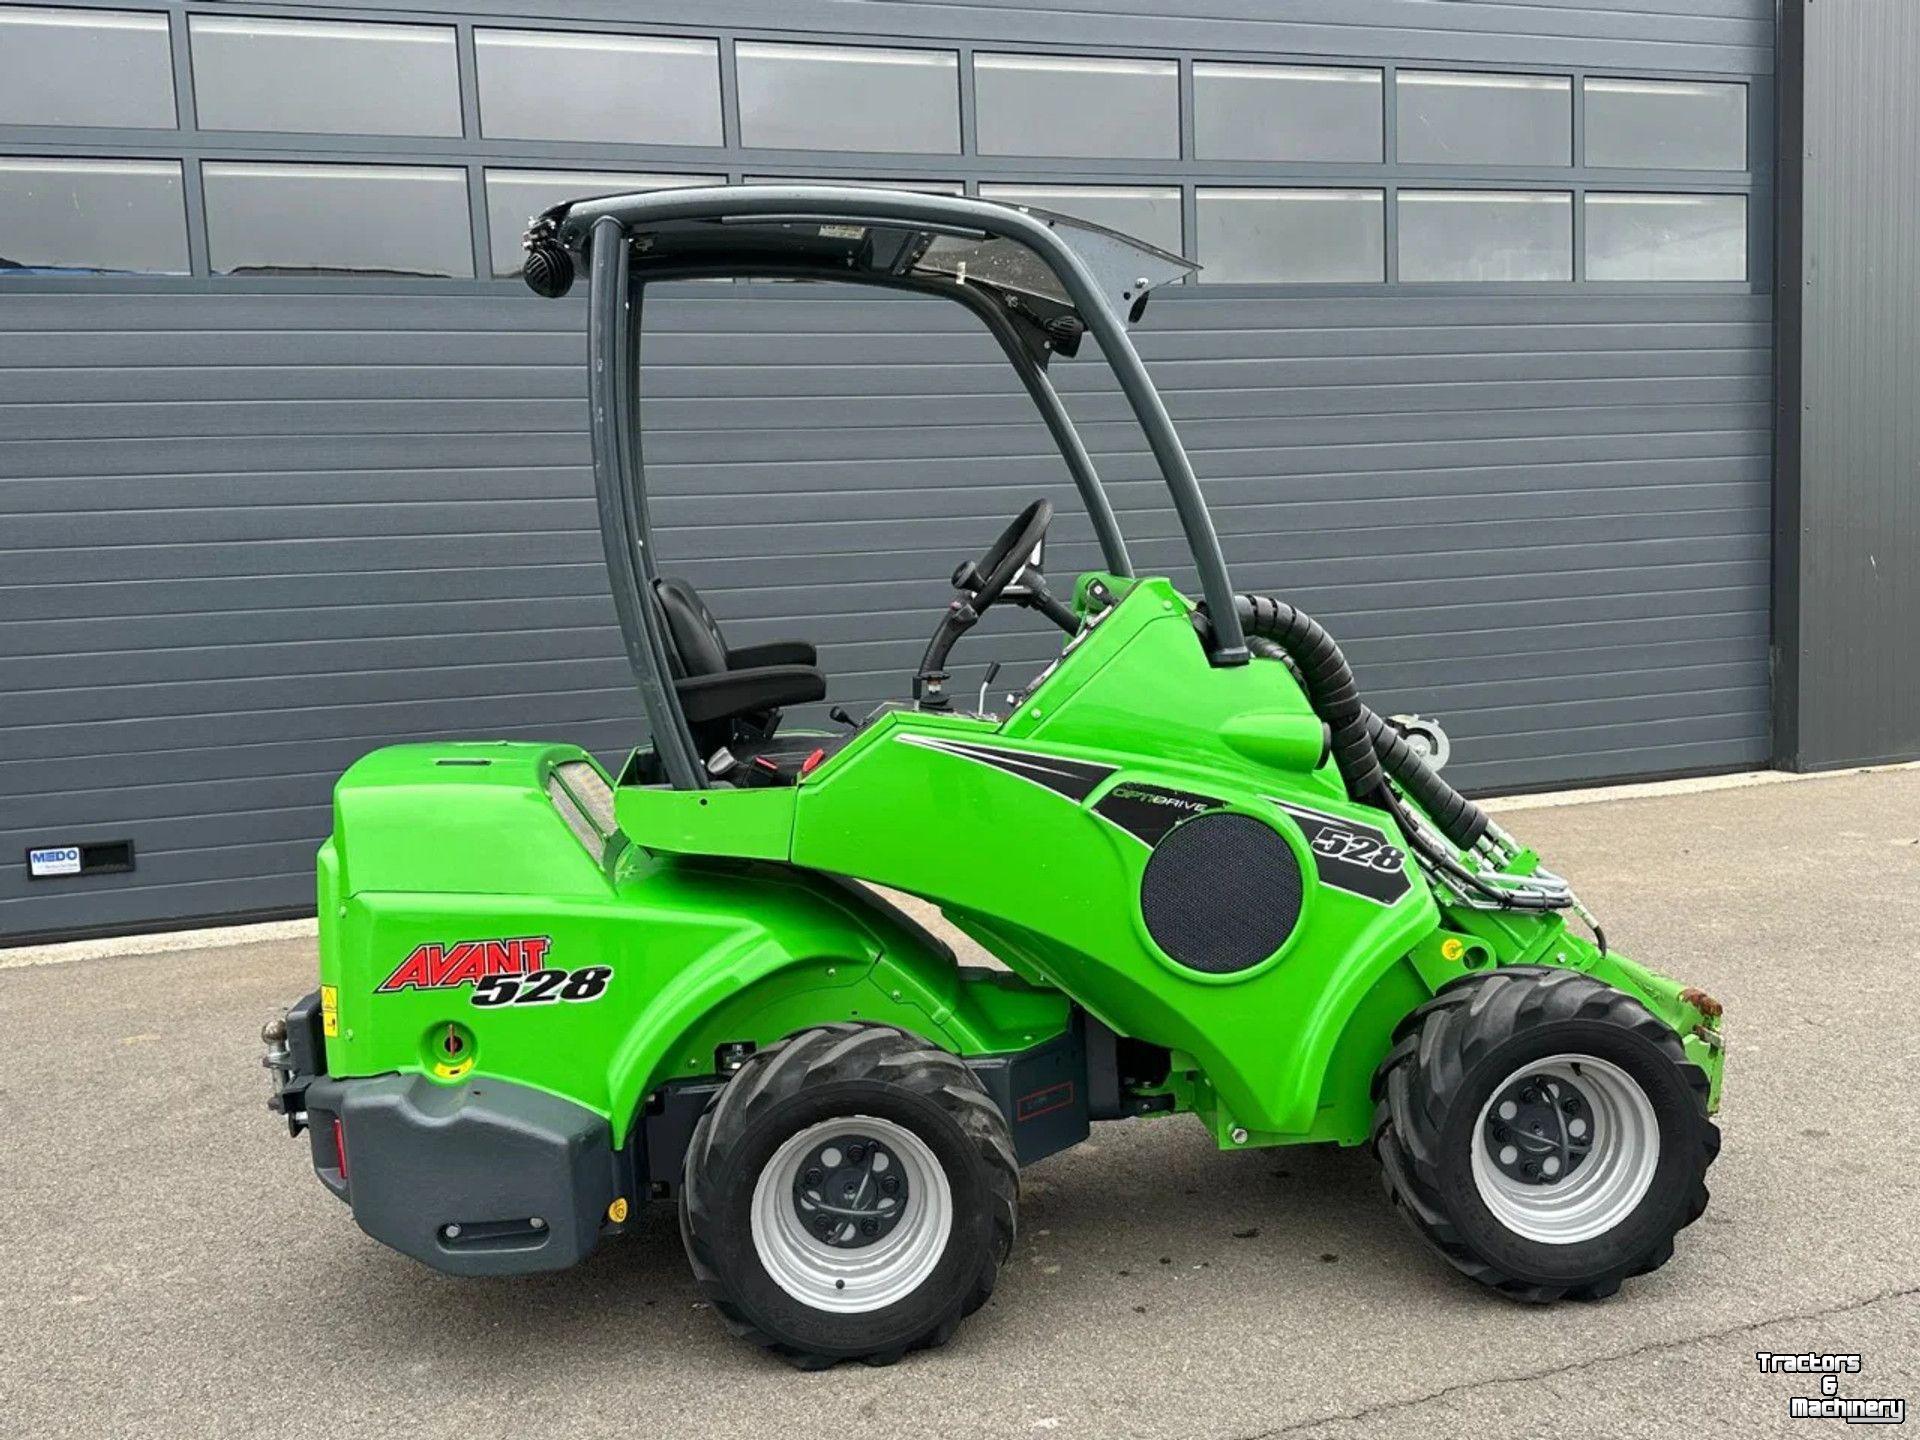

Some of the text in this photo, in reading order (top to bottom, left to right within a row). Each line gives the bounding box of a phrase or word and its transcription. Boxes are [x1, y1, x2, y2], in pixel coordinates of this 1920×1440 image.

[32, 850, 78, 863] MEDO
[1310, 826, 1406, 874] 528
[374, 936, 553, 994] AVANT
[470, 965, 614, 1009] 528
